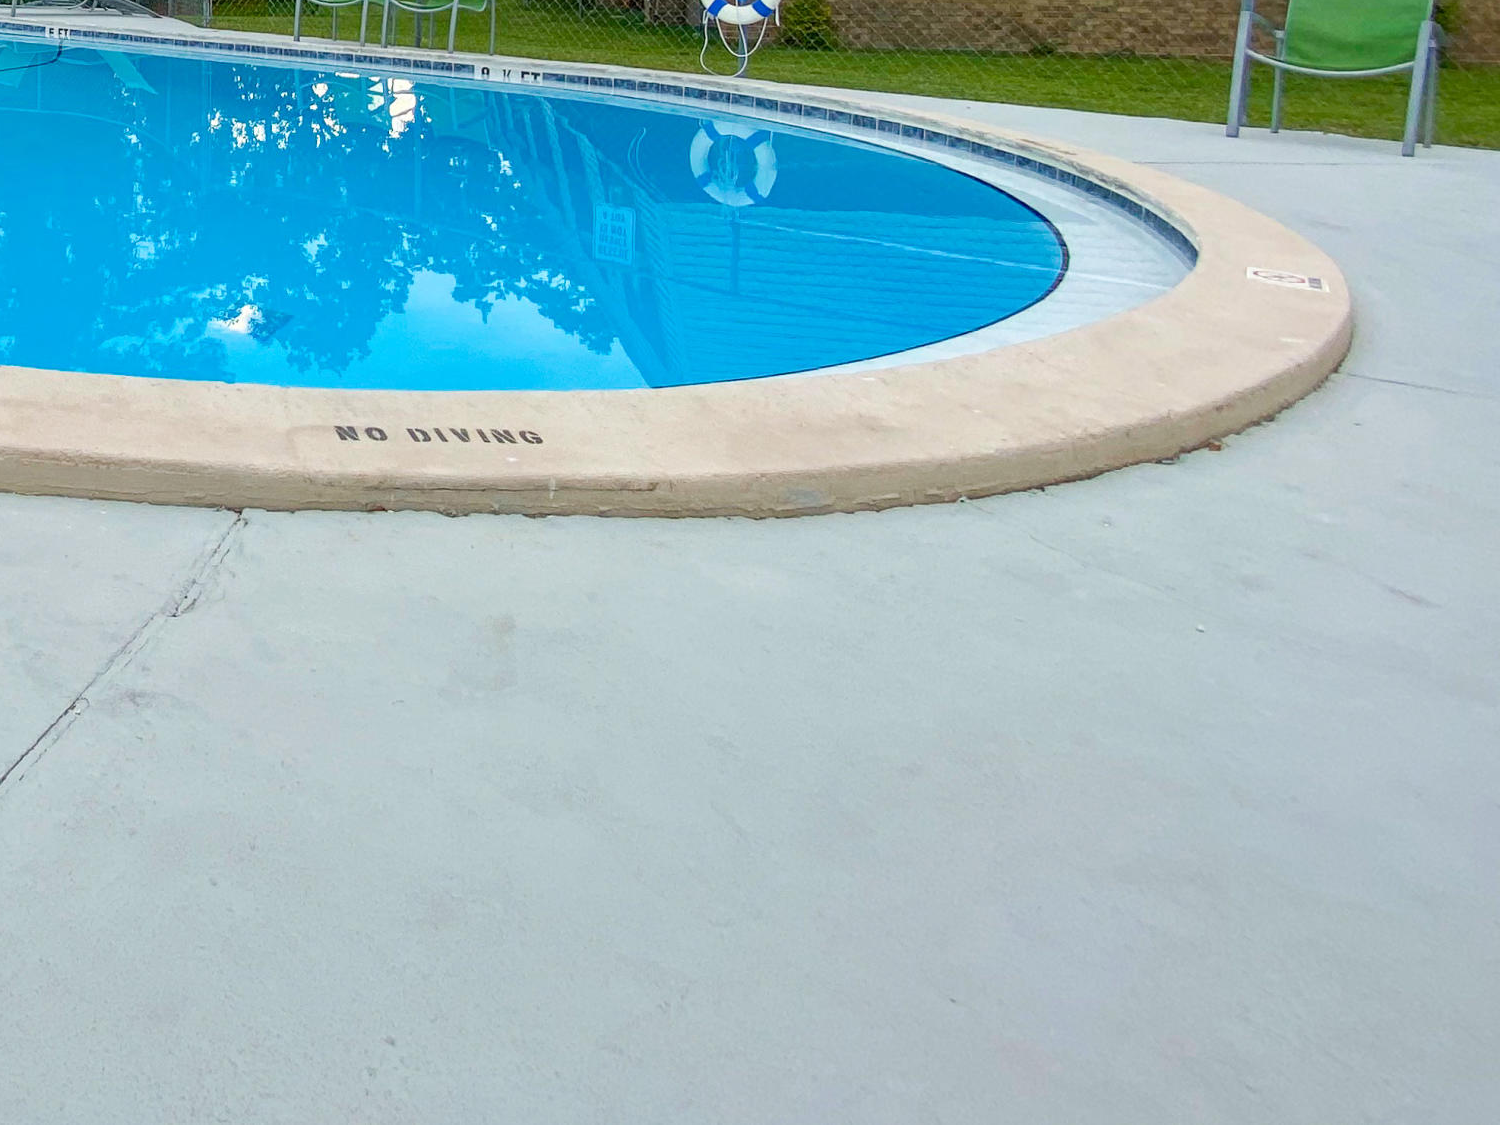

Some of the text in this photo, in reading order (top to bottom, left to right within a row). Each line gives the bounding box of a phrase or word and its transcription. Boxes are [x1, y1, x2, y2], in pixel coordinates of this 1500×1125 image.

[58, 27, 69, 37] FT
[334, 425, 545, 445] NO DIVING
